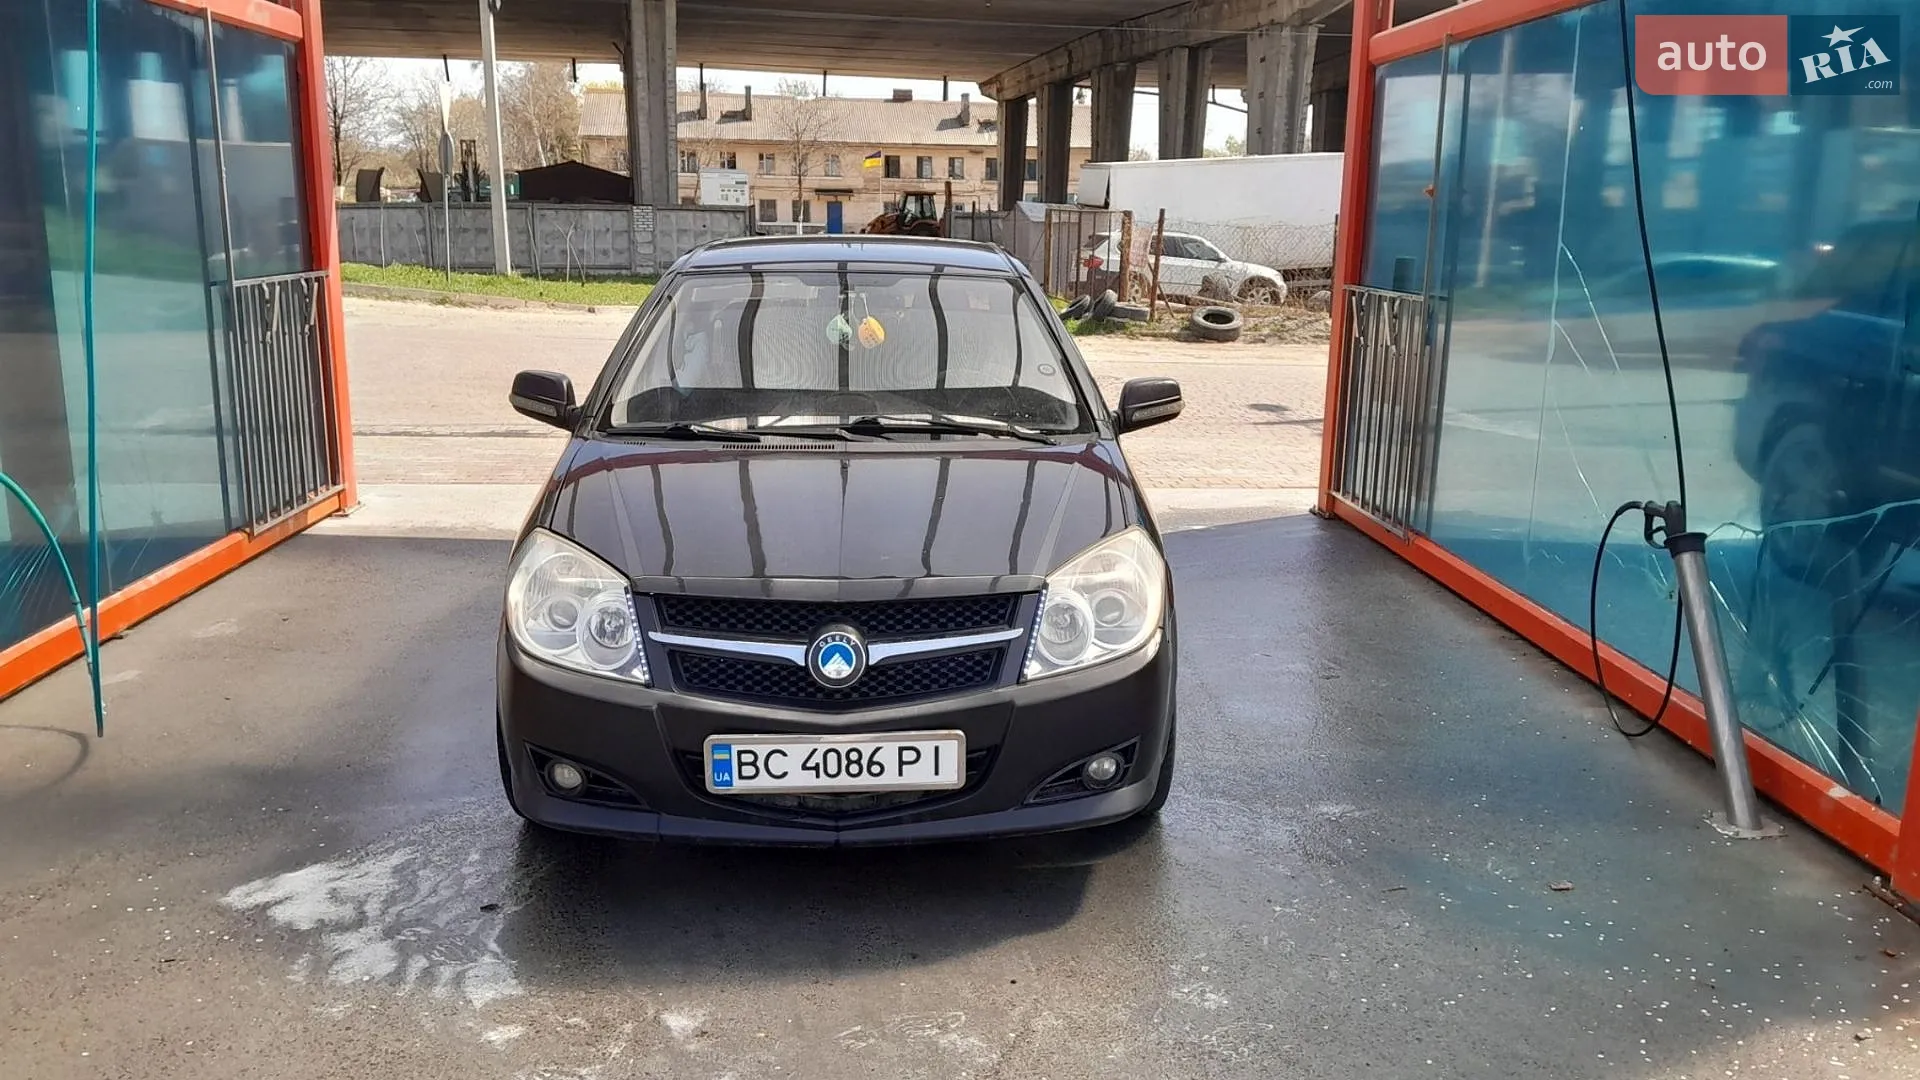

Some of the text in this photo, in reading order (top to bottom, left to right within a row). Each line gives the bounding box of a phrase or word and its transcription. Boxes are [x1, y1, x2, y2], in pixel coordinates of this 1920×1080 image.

[819, 635, 856, 648] GEELY
[736, 748, 788, 780] BC
[801, 746, 885, 780] 4086
[714, 771, 731, 783] UA
